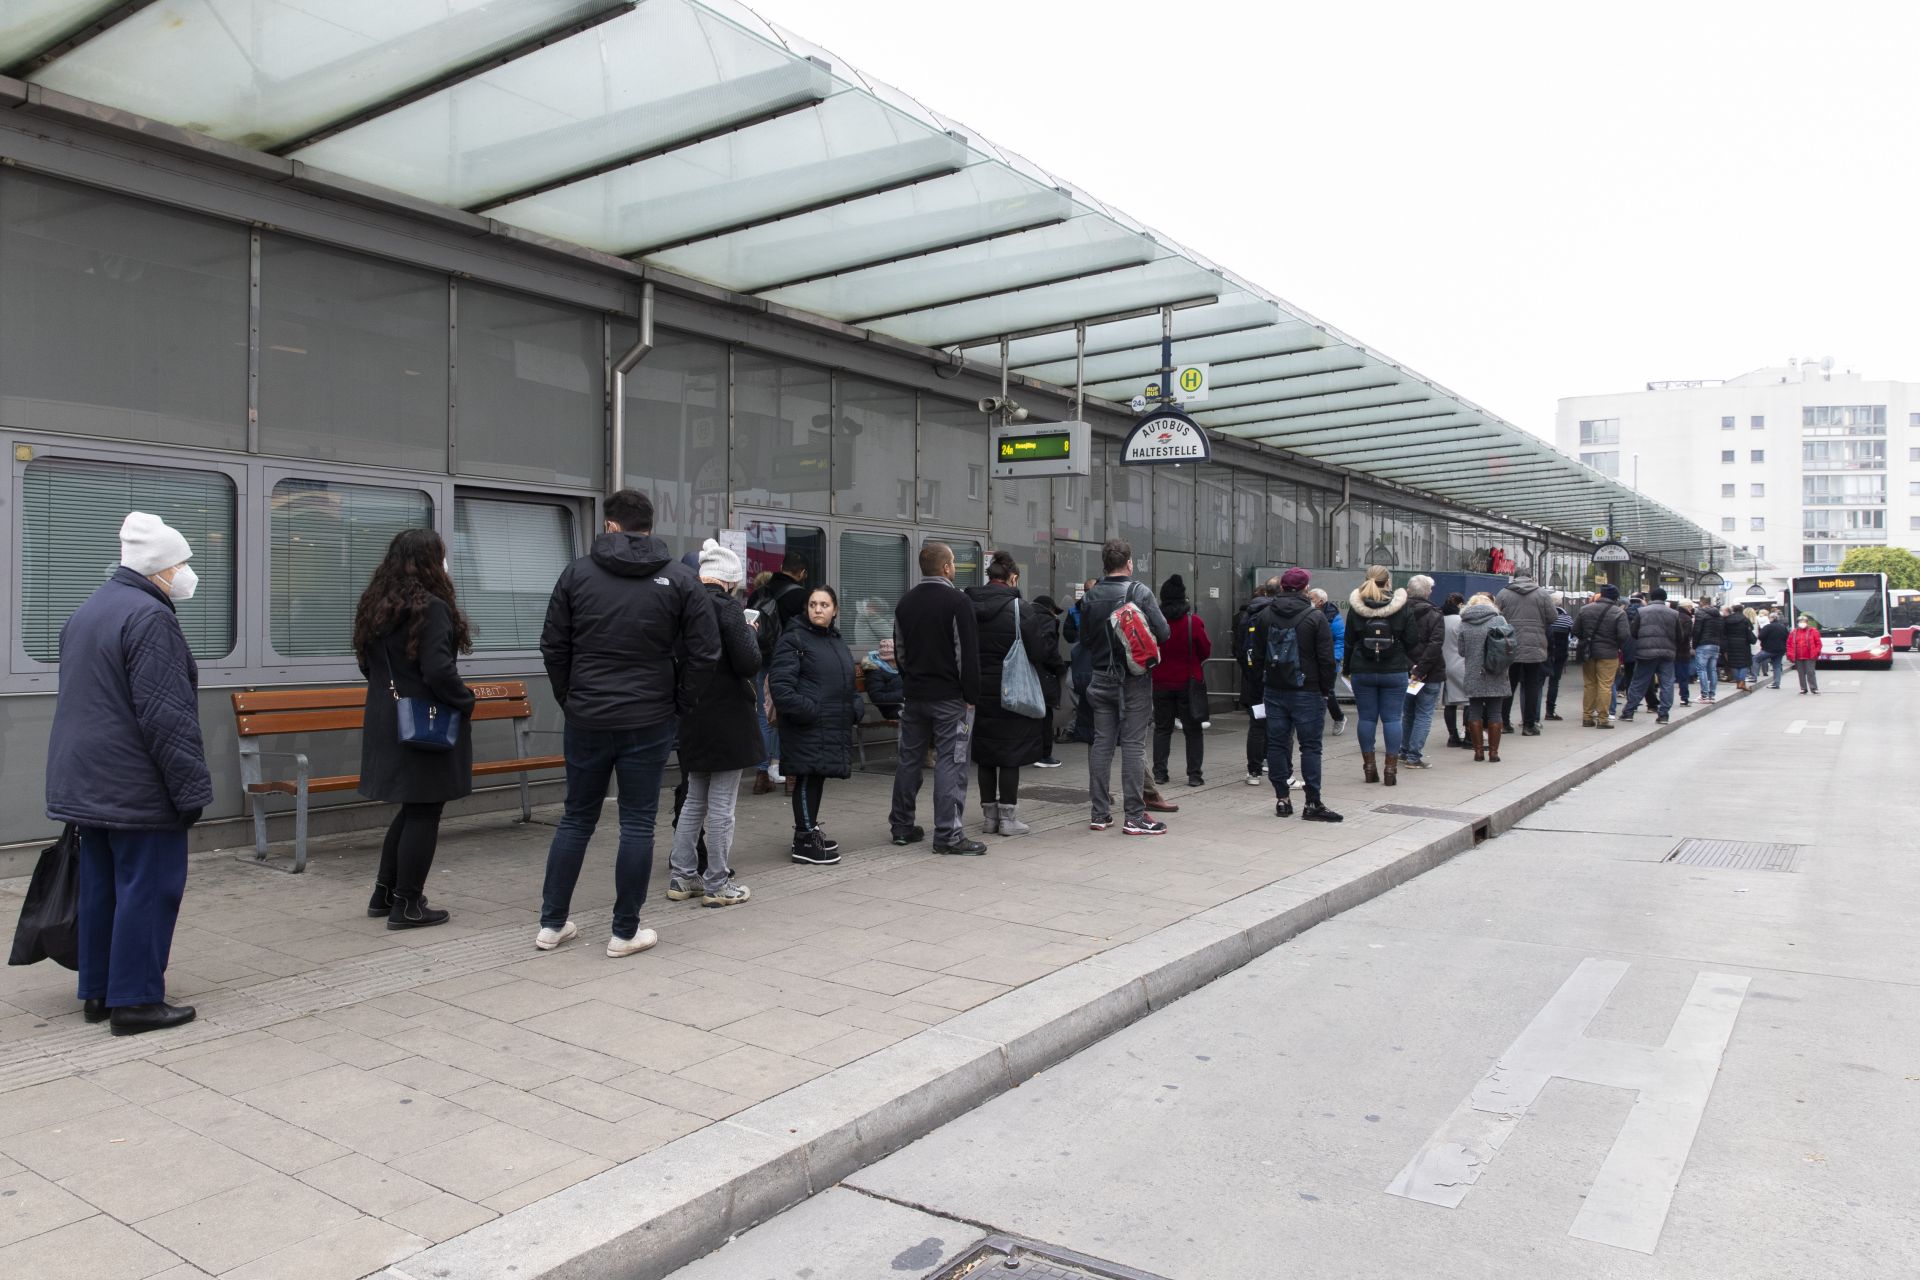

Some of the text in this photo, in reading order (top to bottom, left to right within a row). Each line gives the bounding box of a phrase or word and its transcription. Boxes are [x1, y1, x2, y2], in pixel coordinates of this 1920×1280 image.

[1142, 420, 1190, 438] AUTOBUS
[1064, 440, 1069, 452] 8
[1132, 445, 1198, 458] HALTESTELLE
[1818, 579, 1856, 589] Impfbus
[1384, 957, 1752, 1256] H
